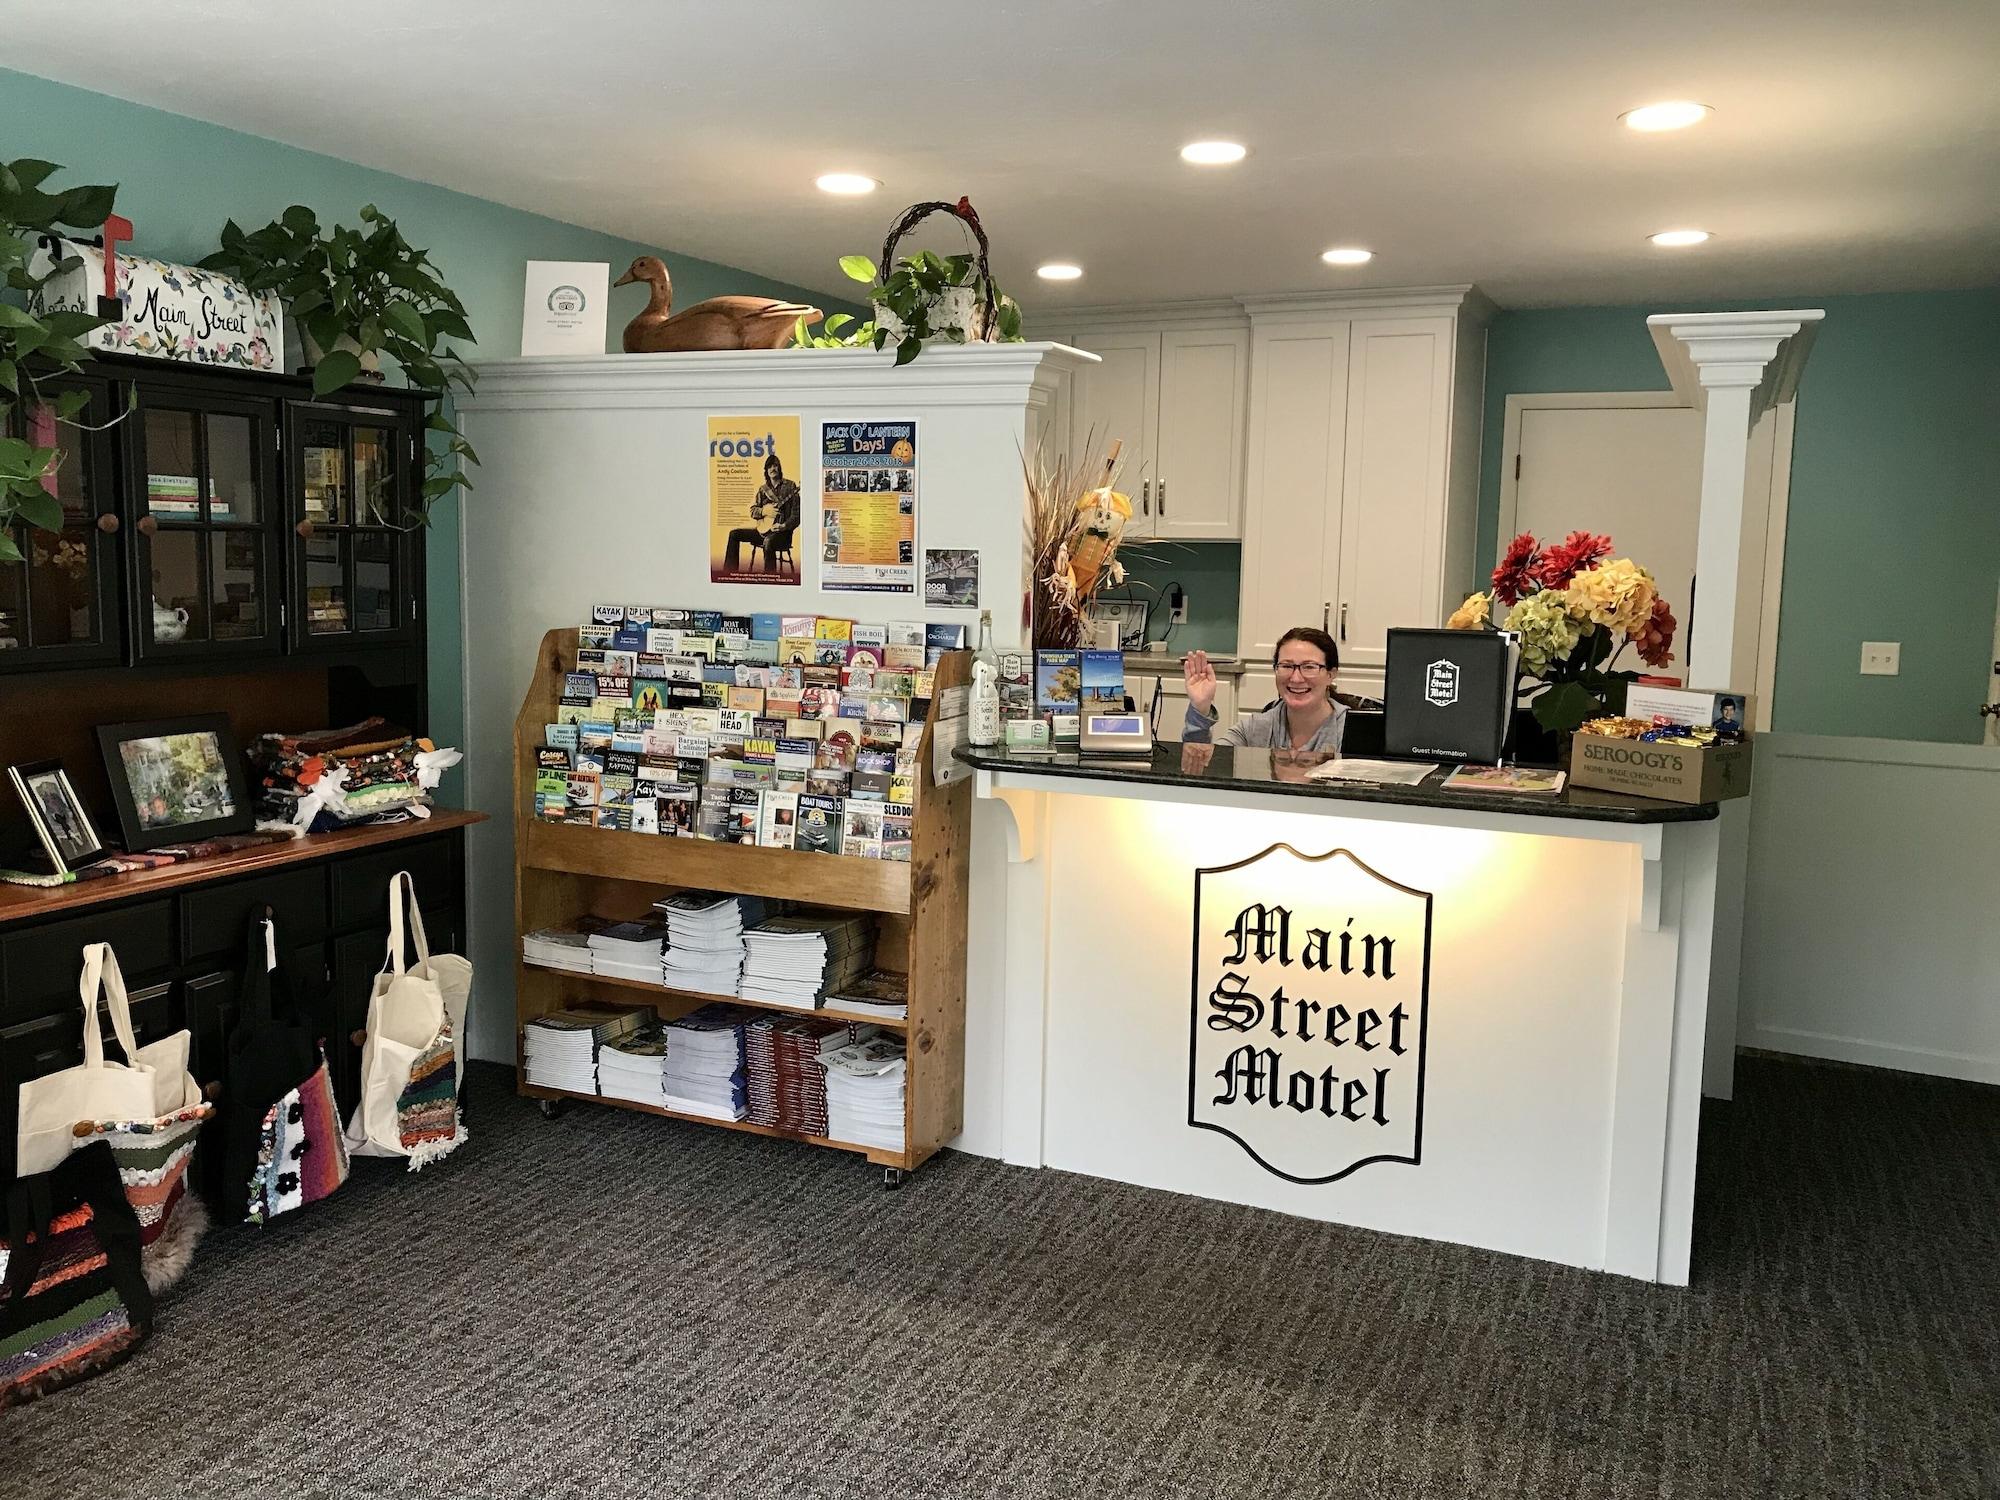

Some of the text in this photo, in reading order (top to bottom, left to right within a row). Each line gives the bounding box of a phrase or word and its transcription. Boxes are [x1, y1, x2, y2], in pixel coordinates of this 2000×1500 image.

[134, 287, 248, 339] Main Street
[826, 427, 849, 439] JACK
[867, 426, 910, 437] LANTERN
[710, 433, 775, 457] roast
[853, 437, 886, 453] Days!
[824, 456, 857, 466] October
[882, 457, 903, 466] 2018
[596, 607, 621, 616] KAYAK
[629, 608, 650, 616] ZIP LIN
[869, 630, 884, 638] BOIL
[1433, 670, 1452, 679] Main
[598, 678, 615, 687] 15%
[616, 678, 629, 688] OFF
[1430, 679, 1453, 688] Street
[1430, 688, 1452, 698] Motel
[722, 710, 736, 720] HAT
[847, 708, 867, 716] Kitche
[720, 720, 742, 730] HEAD
[678, 737, 706, 745] Bargains
[744, 739, 776, 753] KAYAK
[1412, 746, 1468, 757] Guest Information
[1584, 744, 1683, 771] SEROOGY'S
[608, 763, 634, 773] RAFTING
[538, 770, 566, 780] ZIP LINE
[1584, 764, 1604, 774] HOME
[1607, 768, 1626, 776] MADE
[1629, 770, 1682, 784] CHOCOLATES
[892, 778, 913, 788] KAY
[801, 796, 834, 810] BOAT TOURS
[884, 804, 900, 816] SLED
[1223, 903, 1396, 981] Main
[1207, 971, 1409, 1056] Street
[1212, 1044, 1391, 1127] Motel
